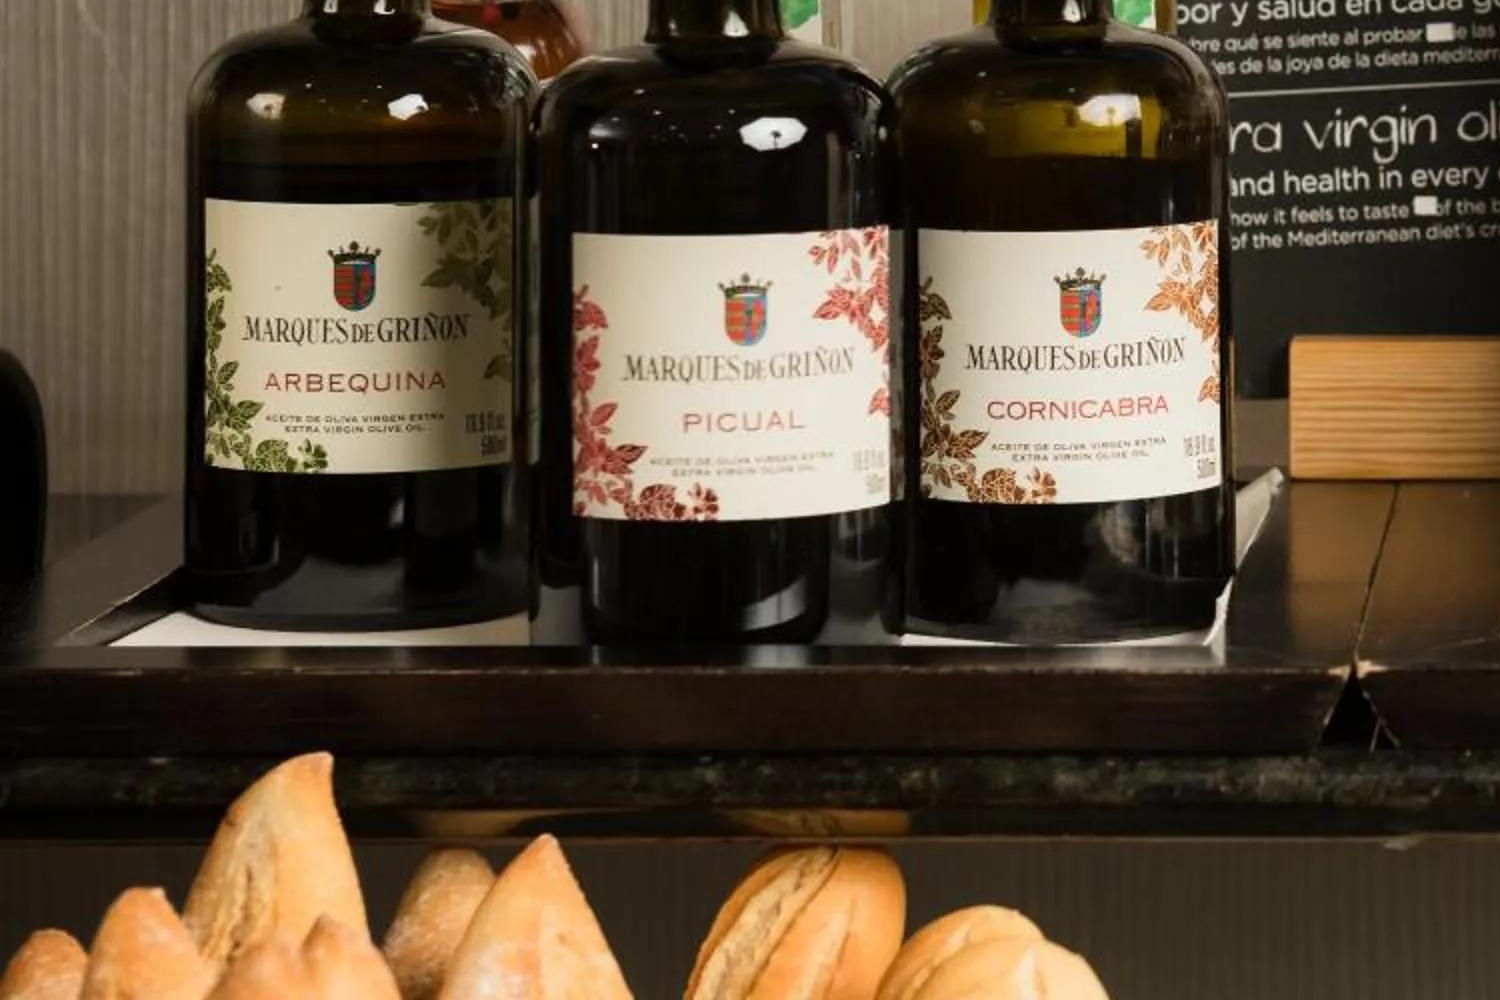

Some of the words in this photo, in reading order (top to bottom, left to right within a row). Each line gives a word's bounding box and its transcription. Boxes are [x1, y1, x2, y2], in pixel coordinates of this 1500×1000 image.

[1230, 0, 1249, 27] y
[1224, 32, 1259, 55] qué
[1263, 35, 1283, 49] se
[1287, 30, 1340, 48] siente
[1343, 28, 1360, 45] al
[1363, 26, 1423, 46] probar
[1472, 23, 1496, 39] las
[1239, 57, 1263, 73] de
[1267, 55, 1283, 72] la
[1286, 54, 1324, 75] joya
[1327, 53, 1351, 69] de
[1355, 52, 1371, 68] la
[1374, 49, 1419, 67] dieta
[1303, 105, 1438, 164] virgin
[1283, 165, 1370, 195] health
[1377, 164, 1402, 189] in
[1411, 165, 1489, 190] every
[1274, 206, 1287, 224] it
[1291, 205, 1334, 223] feels
[1338, 205, 1358, 221] to
[1363, 202, 1410, 220] taste
[1456, 197, 1486, 214] the
[1252, 232, 1282, 249] the
[1287, 227, 1421, 247] Mediterranean
[1426, 222, 1476, 240] diet's
[242, 315, 349, 345] MARQUES
[377, 312, 470, 343] GRIÑON
[623, 354, 740, 383] MARQUES
[769, 346, 856, 379] GRIÑON
[964, 343, 1075, 373] MARQUES
[1103, 335, 1186, 369] GRIÑON
[265, 370, 446, 394] ARBEQUINA
[683, 408, 806, 433] PICUAL
[987, 395, 1169, 421] CORNICABRA
